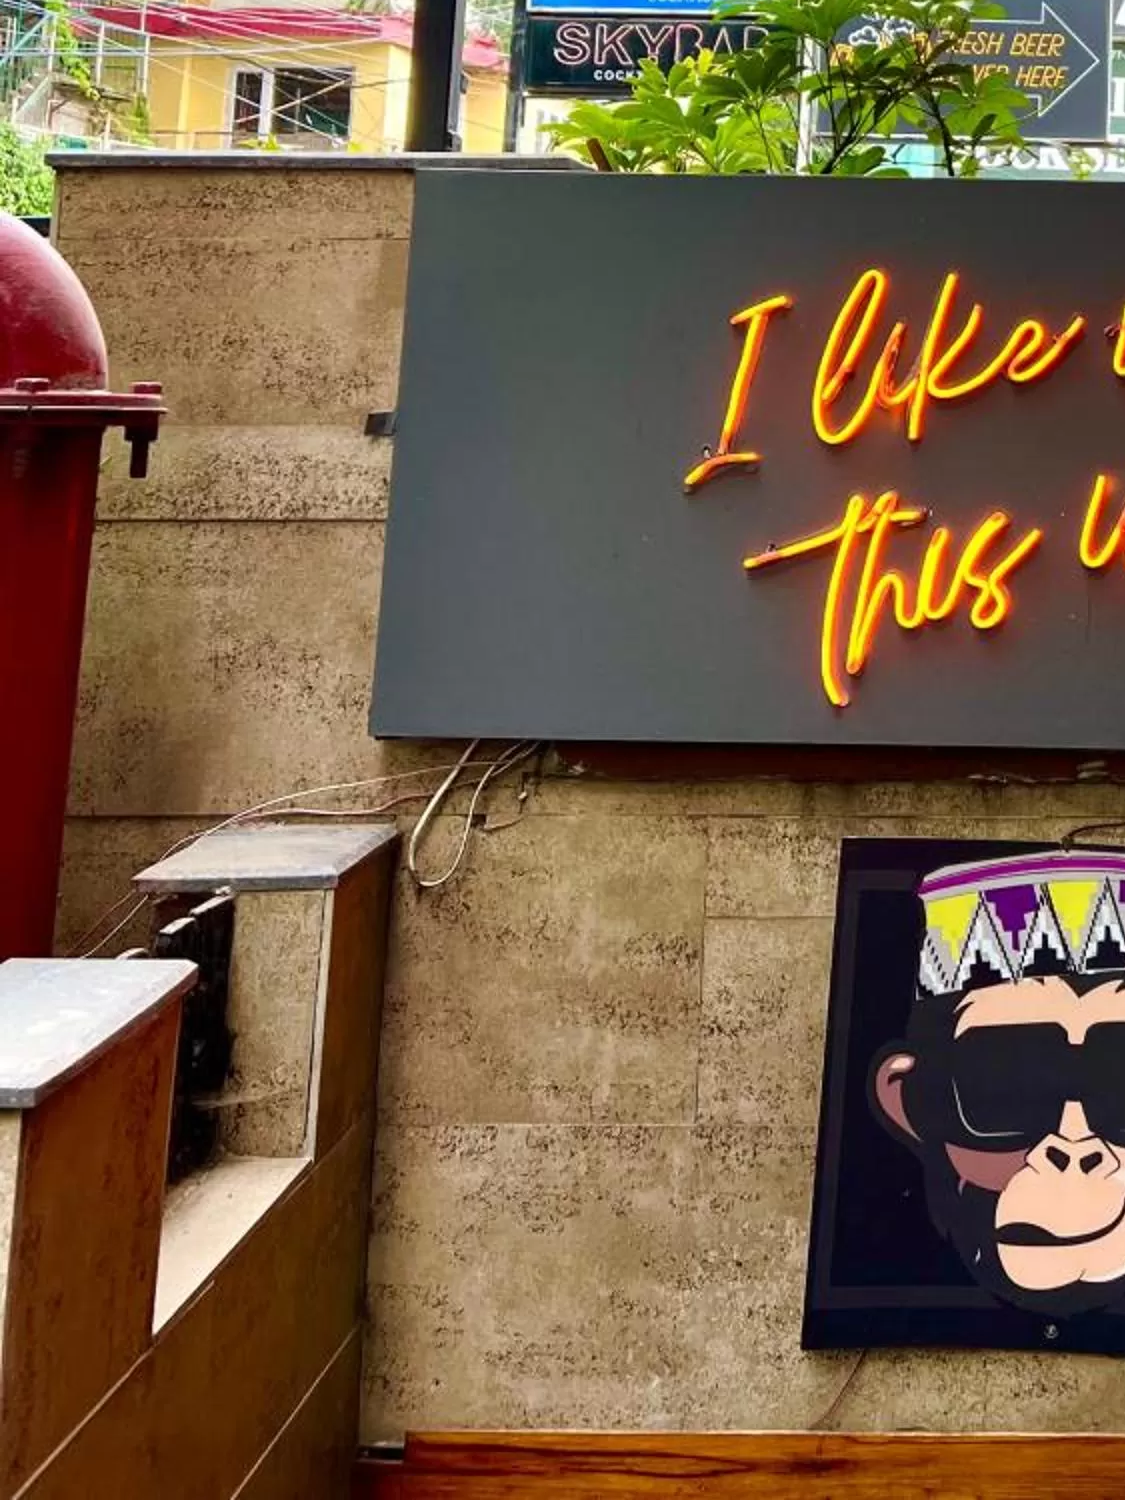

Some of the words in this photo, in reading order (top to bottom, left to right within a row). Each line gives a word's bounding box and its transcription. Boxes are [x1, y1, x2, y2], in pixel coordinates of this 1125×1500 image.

[1009, 32, 1067, 58] BEER
[682, 294, 793, 493] I
[811, 266, 1085, 447] like
